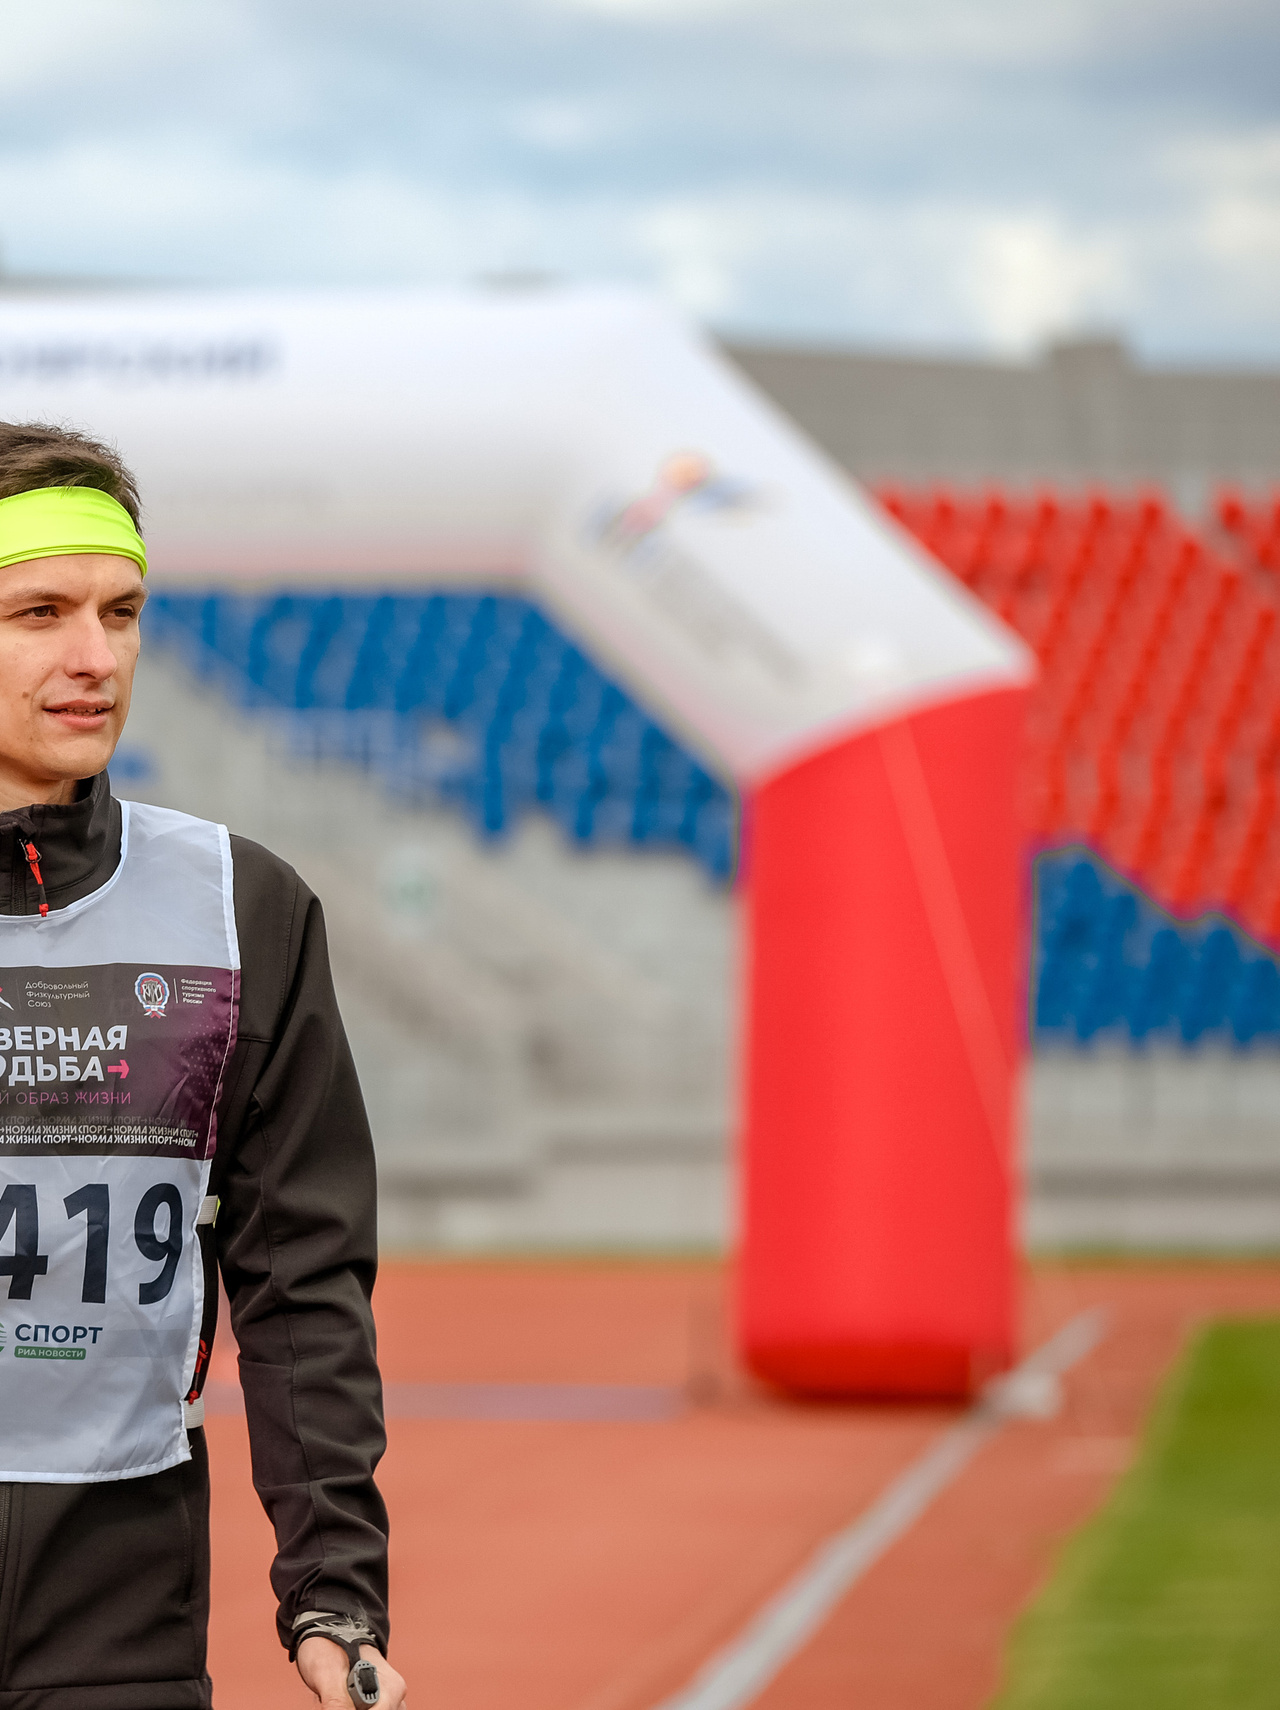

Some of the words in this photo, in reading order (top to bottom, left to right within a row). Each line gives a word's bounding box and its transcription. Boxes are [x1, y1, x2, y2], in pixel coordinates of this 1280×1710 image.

[25, 981, 89, 990] Добровольный
[26, 991, 90, 1000] Физкультурный
[27, 1000, 51, 1008] Союз
[15, 1091, 69, 1105] ОБРАЗ
[74, 1091, 131, 1105] ЖИЗНИ
[42, 1124, 77, 1134] ЖИЗНИ
[148, 1125, 179, 1137] ЖИЗНИ
[5, 1134, 41, 1144] ЖИЗНИ
[113, 1134, 148, 1144] ЖИЗНИ
[15, 1323, 103, 1344] СПОРТ
[17, 1348, 37, 1357] РИА
[38, 1348, 84, 1358] НОВОСТИ
